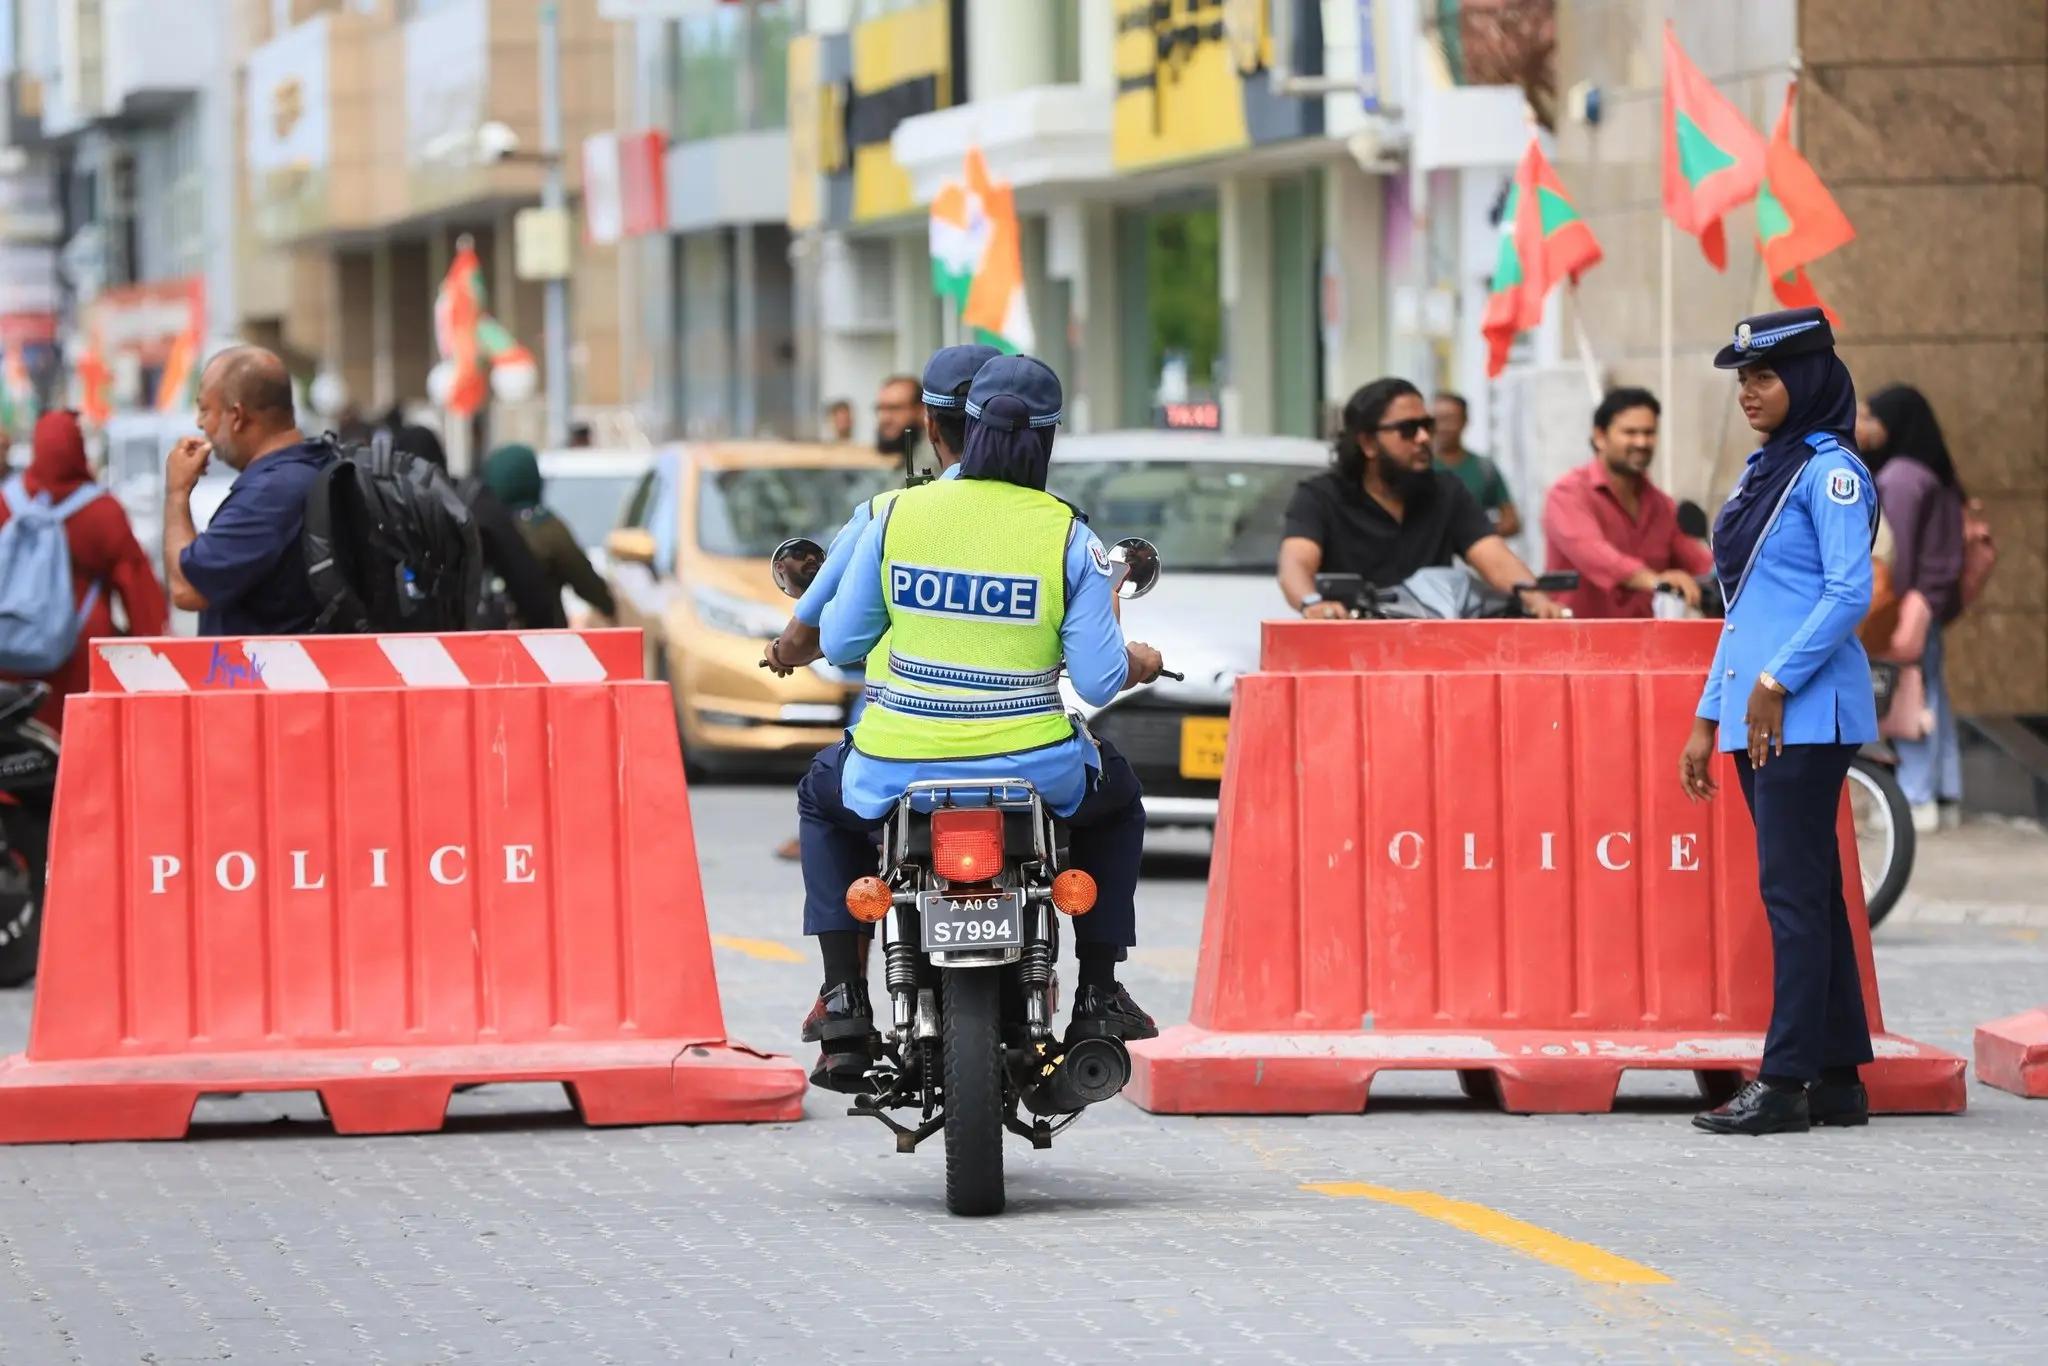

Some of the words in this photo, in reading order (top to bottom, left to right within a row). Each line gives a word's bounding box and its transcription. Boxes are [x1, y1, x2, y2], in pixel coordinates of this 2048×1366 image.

[893, 569, 1034, 616] POLICE
[149, 843, 537, 895] POLICE
[1328, 830, 1700, 872] OLICE
[986, 897, 999, 910] G
[933, 918, 1012, 943] S7994
